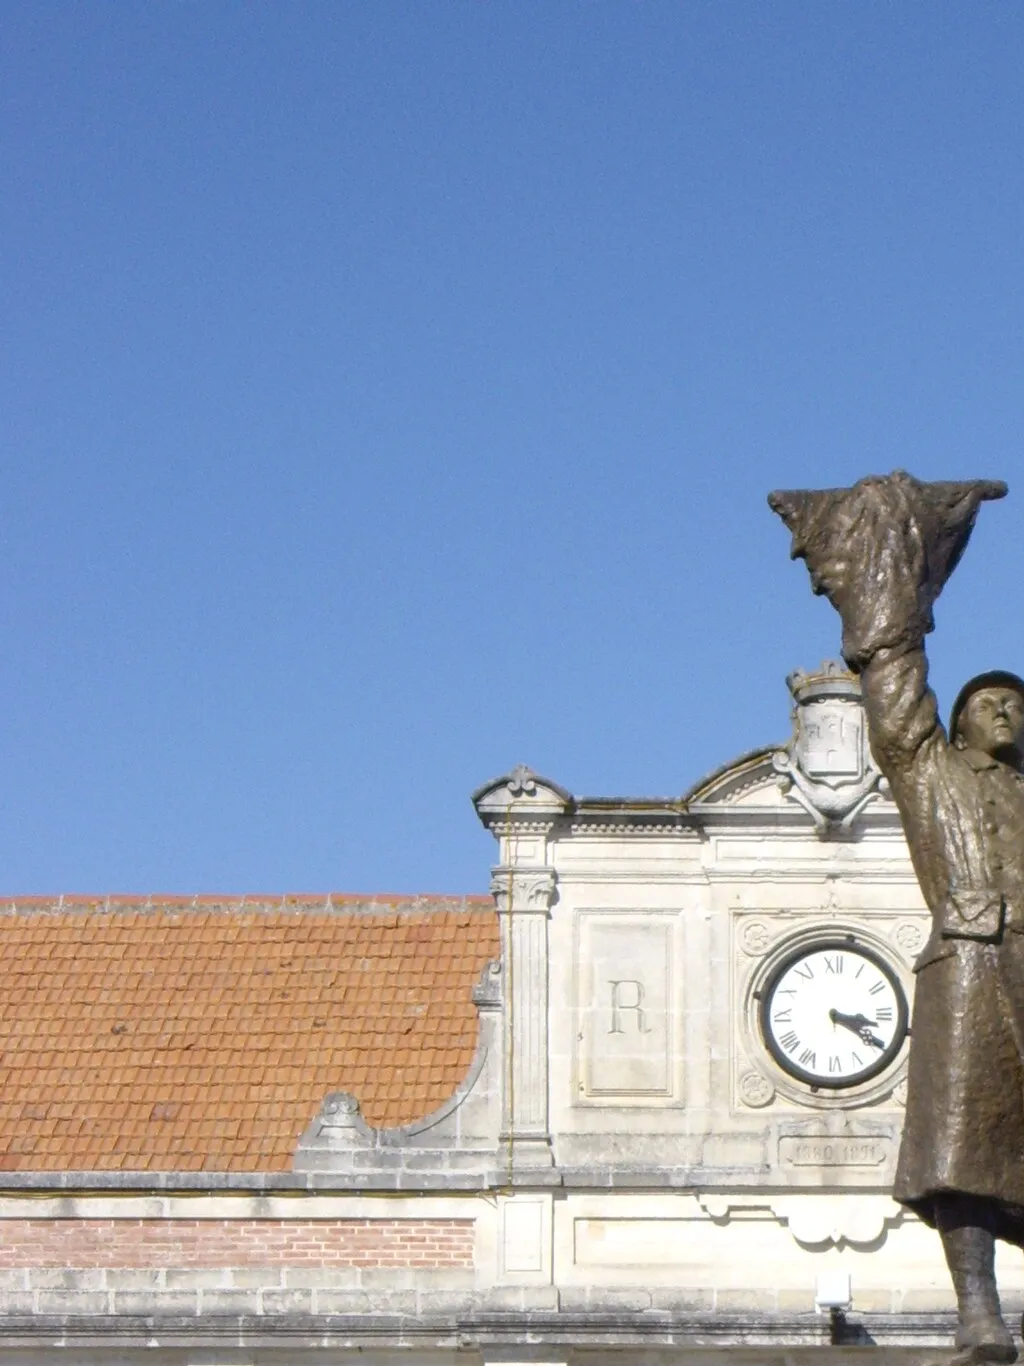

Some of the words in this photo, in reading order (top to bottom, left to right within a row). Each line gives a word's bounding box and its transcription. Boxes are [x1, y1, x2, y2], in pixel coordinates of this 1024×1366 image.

[824, 956, 844, 974] XII
[868, 980, 886, 995] II
[607, 980, 653, 1035] R
[774, 1008, 792, 1022] IX
[875, 1007, 893, 1021] III
[779, 1030, 801, 1053] VIII
[798, 1048, 816, 1069] VII
[829, 1056, 842, 1072] VI
[851, 1051, 864, 1068] V
